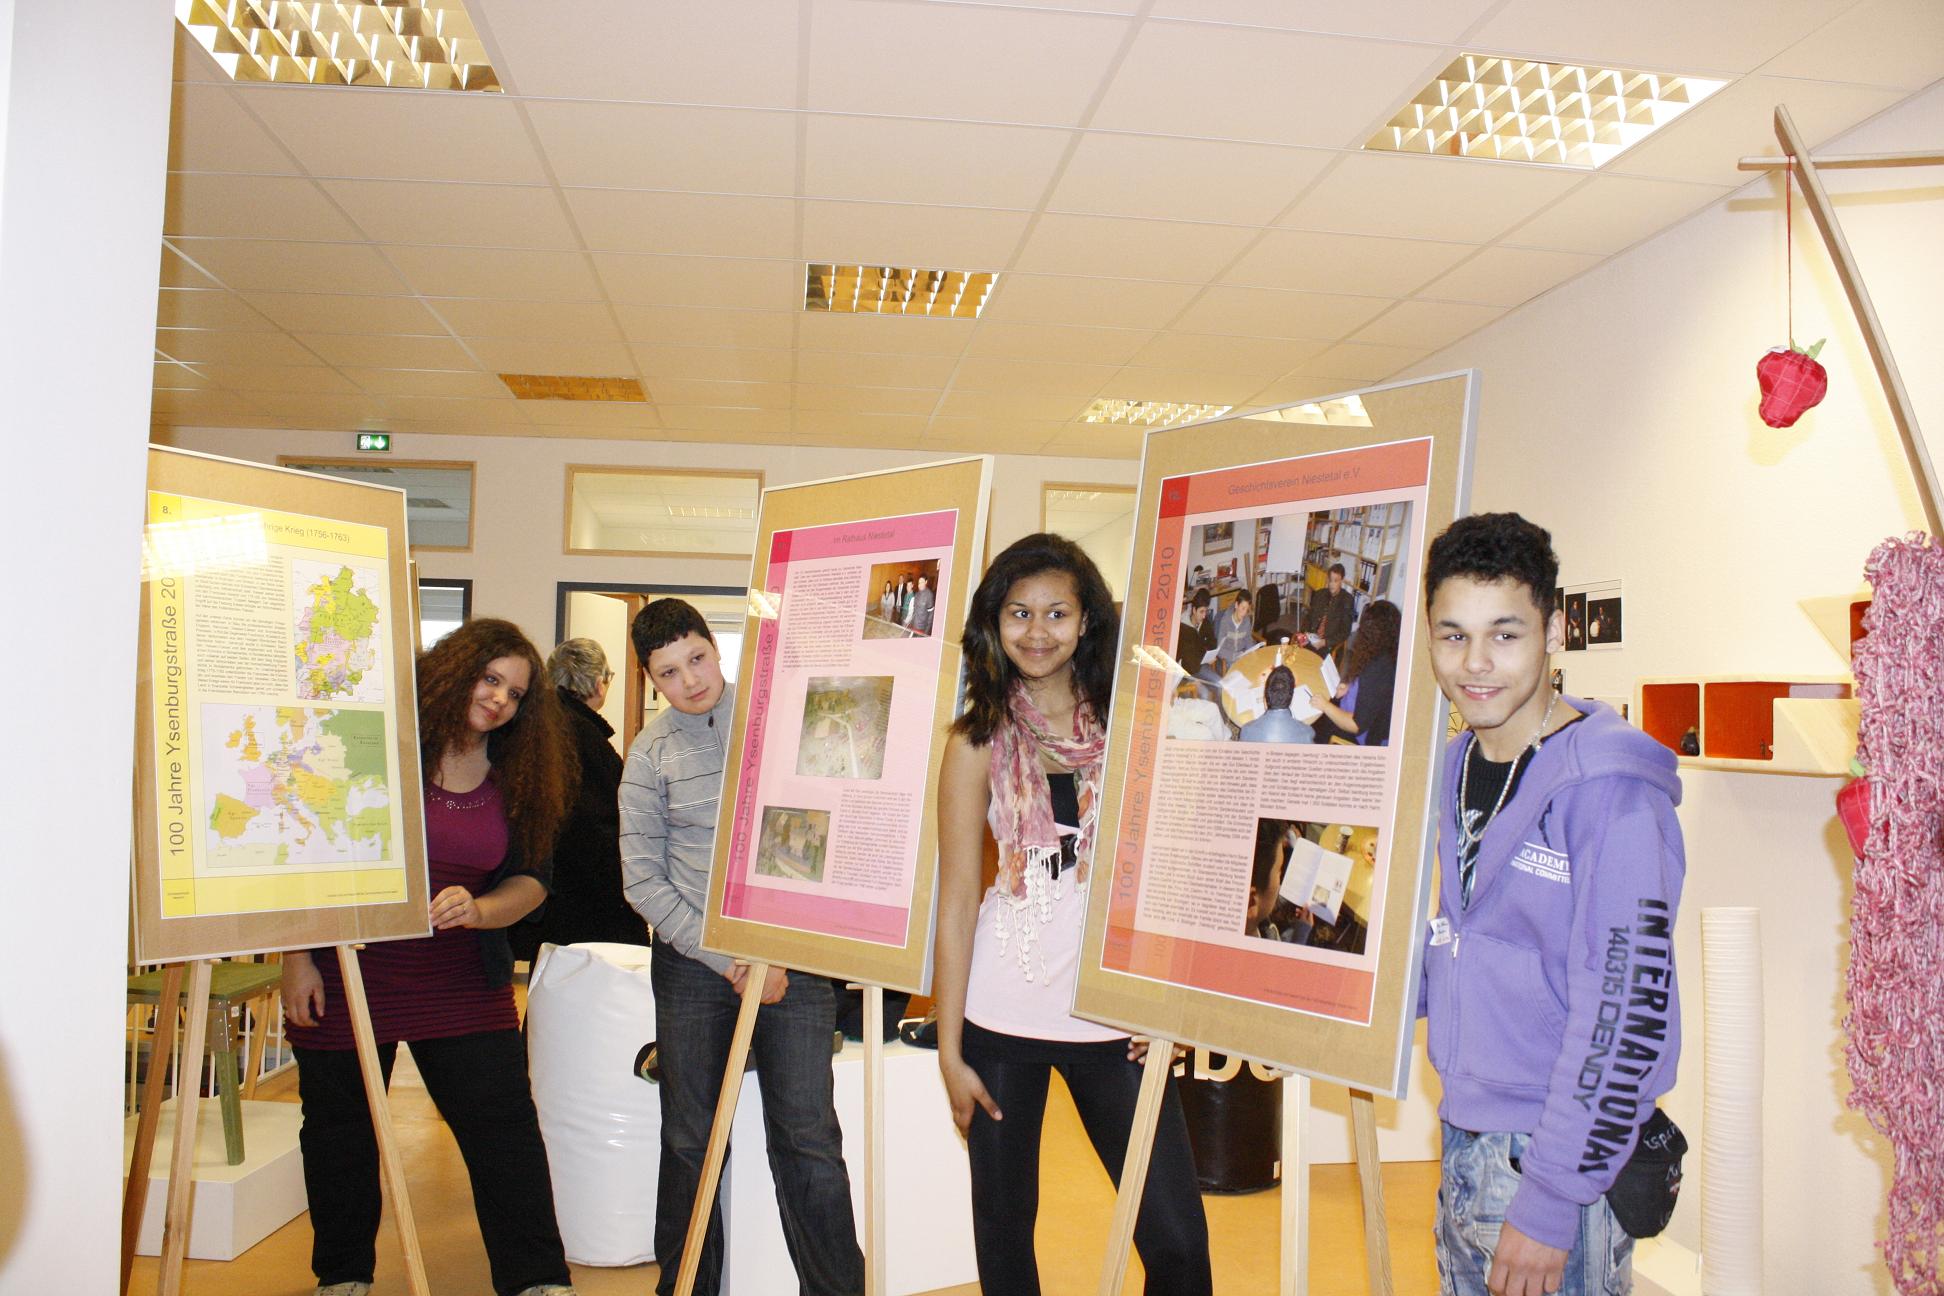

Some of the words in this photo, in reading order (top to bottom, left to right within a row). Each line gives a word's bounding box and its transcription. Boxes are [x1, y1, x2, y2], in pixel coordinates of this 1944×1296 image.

[1227, 477, 1300, 496] Geschichtsverein
[1303, 470, 1342, 486] Niestetal
[284, 525, 305, 538] Krieg
[306, 528, 351, 544] (1756-1763)
[1156, 546, 1175, 601] 2010
[162, 605, 182, 755] Ysenburgstraße
[746, 633, 774, 772] Ysenburgstraße
[1134, 609, 1168, 784] Ysenburgsaße
[168, 761, 183, 815] Jahre
[739, 778, 754, 826] Jahre
[169, 821, 185, 856] 100
[1125, 790, 1145, 854] Jahre
[1119, 861, 1136, 904] 100
[1601, 924, 1630, 996] 140315
[1572, 999, 1621, 1113] DENDY
